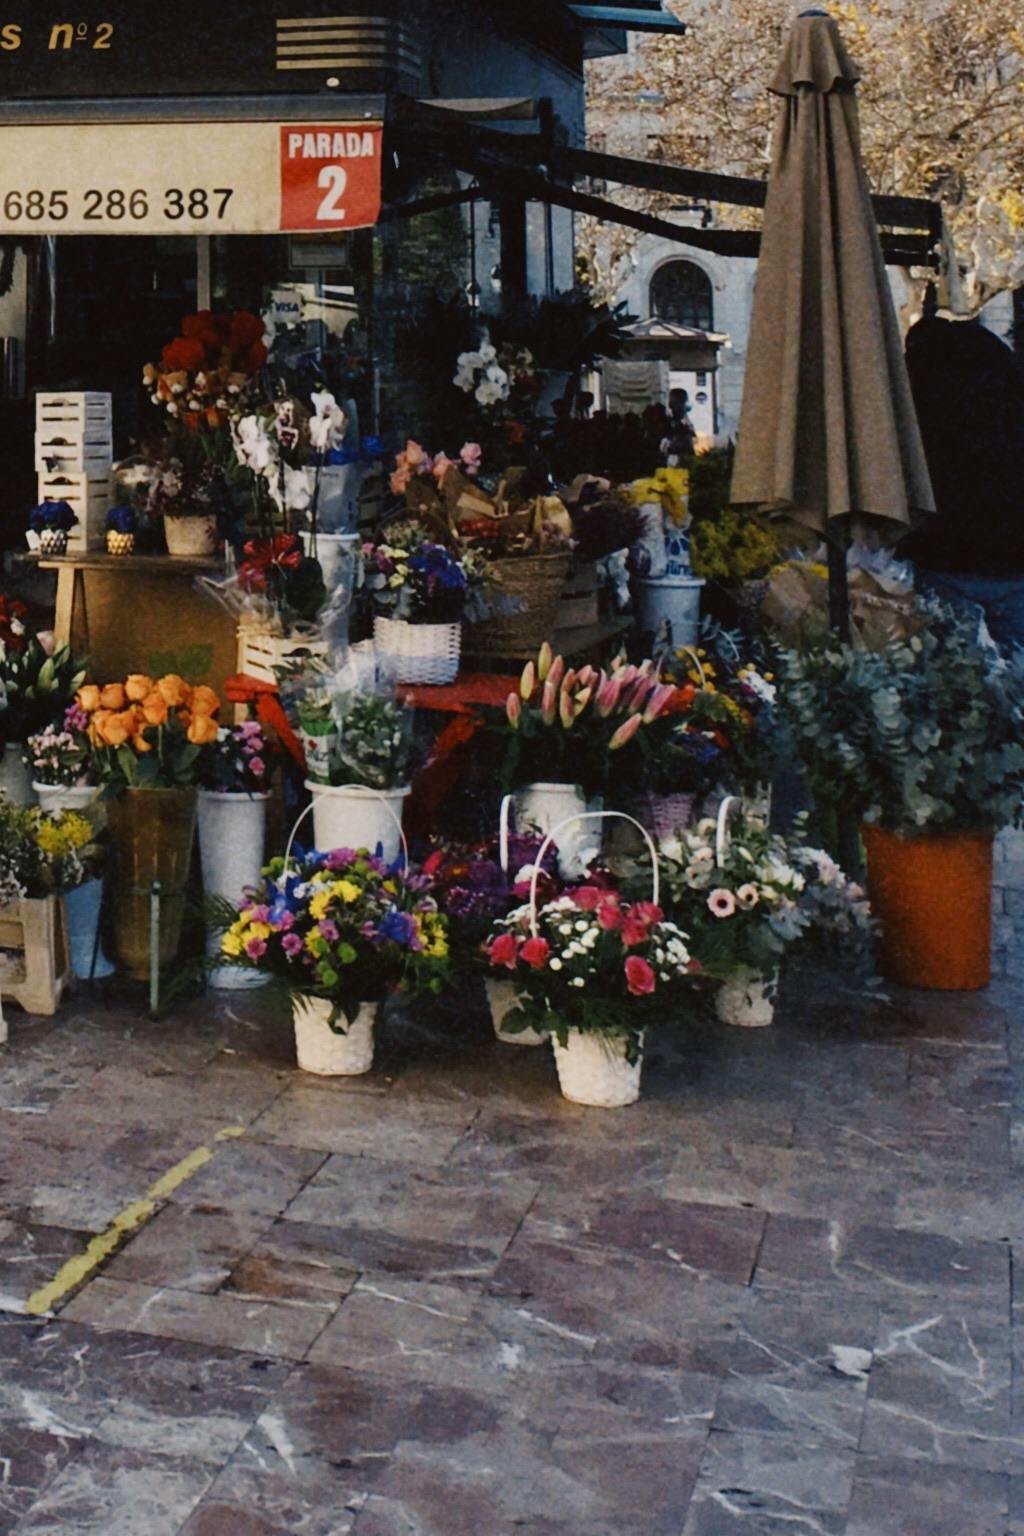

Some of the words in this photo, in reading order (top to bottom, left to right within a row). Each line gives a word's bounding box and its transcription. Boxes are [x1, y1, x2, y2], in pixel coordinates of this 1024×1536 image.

[288, 132, 374, 158] PARADA
[3, 189, 69, 221] 685
[82, 189, 149, 220] 286
[163, 187, 234, 220] 387
[316, 165, 347, 220] 2
[275, 302, 300, 313] VISA
